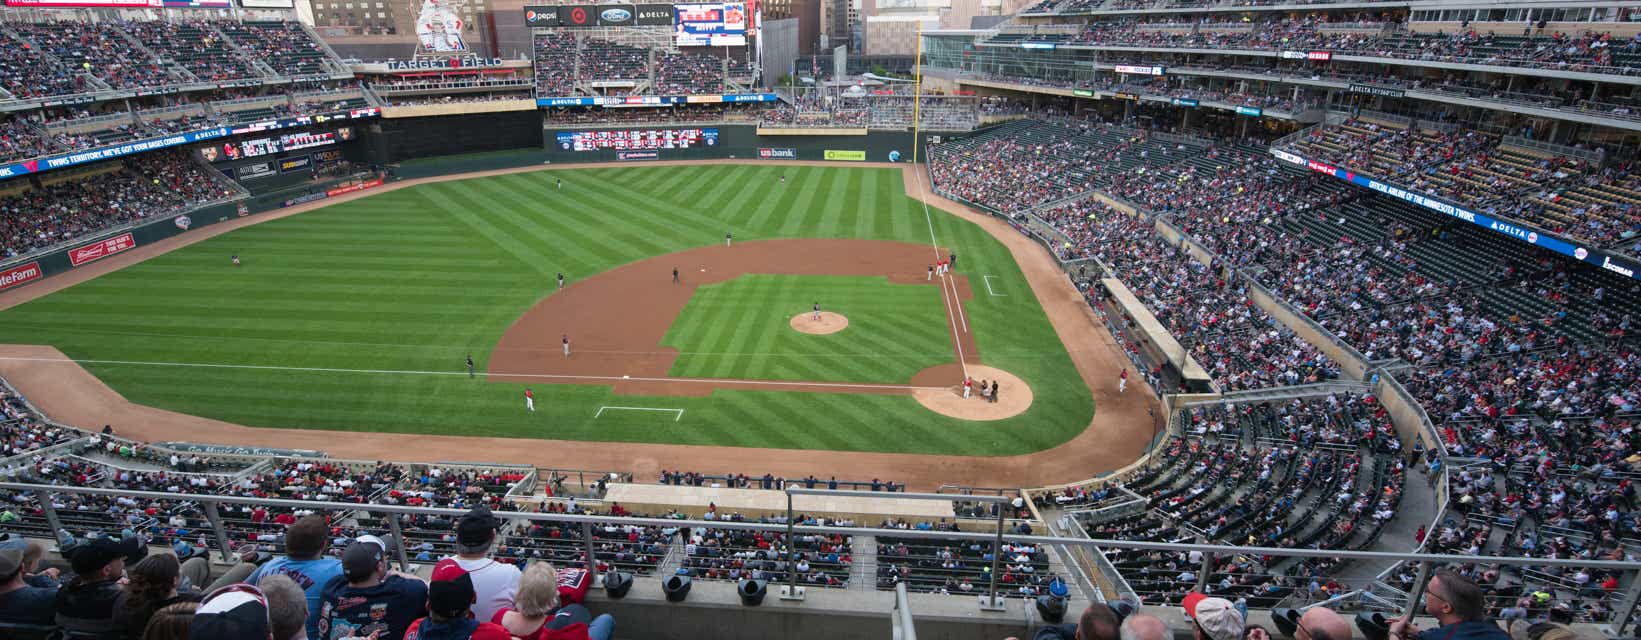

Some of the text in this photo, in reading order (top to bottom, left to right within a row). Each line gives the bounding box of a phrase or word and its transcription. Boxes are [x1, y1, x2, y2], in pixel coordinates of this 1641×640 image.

[537, 11, 556, 20] pepsi
[387, 57, 503, 70] TARGET FIELD
[200, 131, 220, 139] DELTA
[48, 156, 70, 168] TWINS
[121, 146, 132, 154] GOT
[133, 143, 148, 152] YOUR
[1406, 191, 1414, 201] OF
[1413, 194, 1424, 205] THE
[1424, 197, 1455, 216] MINNESOTA
[1498, 223, 1525, 238] DELTA
